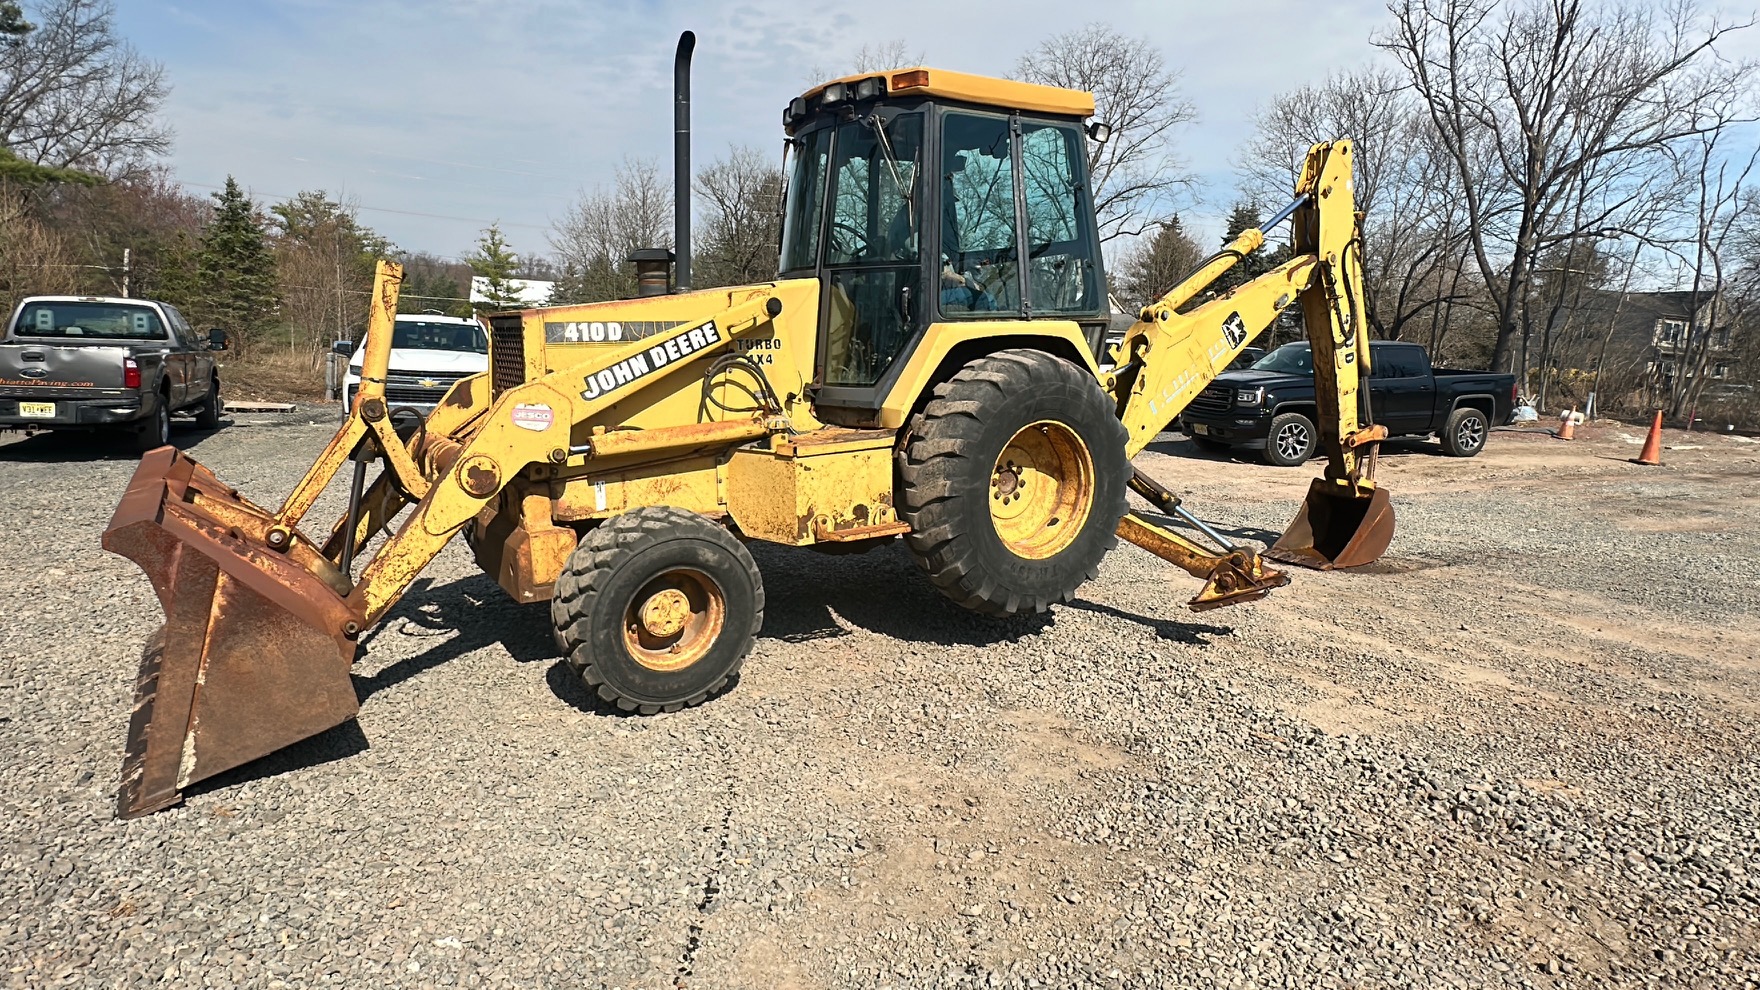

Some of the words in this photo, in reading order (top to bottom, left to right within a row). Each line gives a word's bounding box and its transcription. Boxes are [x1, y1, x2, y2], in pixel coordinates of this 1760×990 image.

[584, 353, 650, 399] JOHN
[649, 322, 719, 368] DEERE
[736, 338, 781, 350] TURBO
